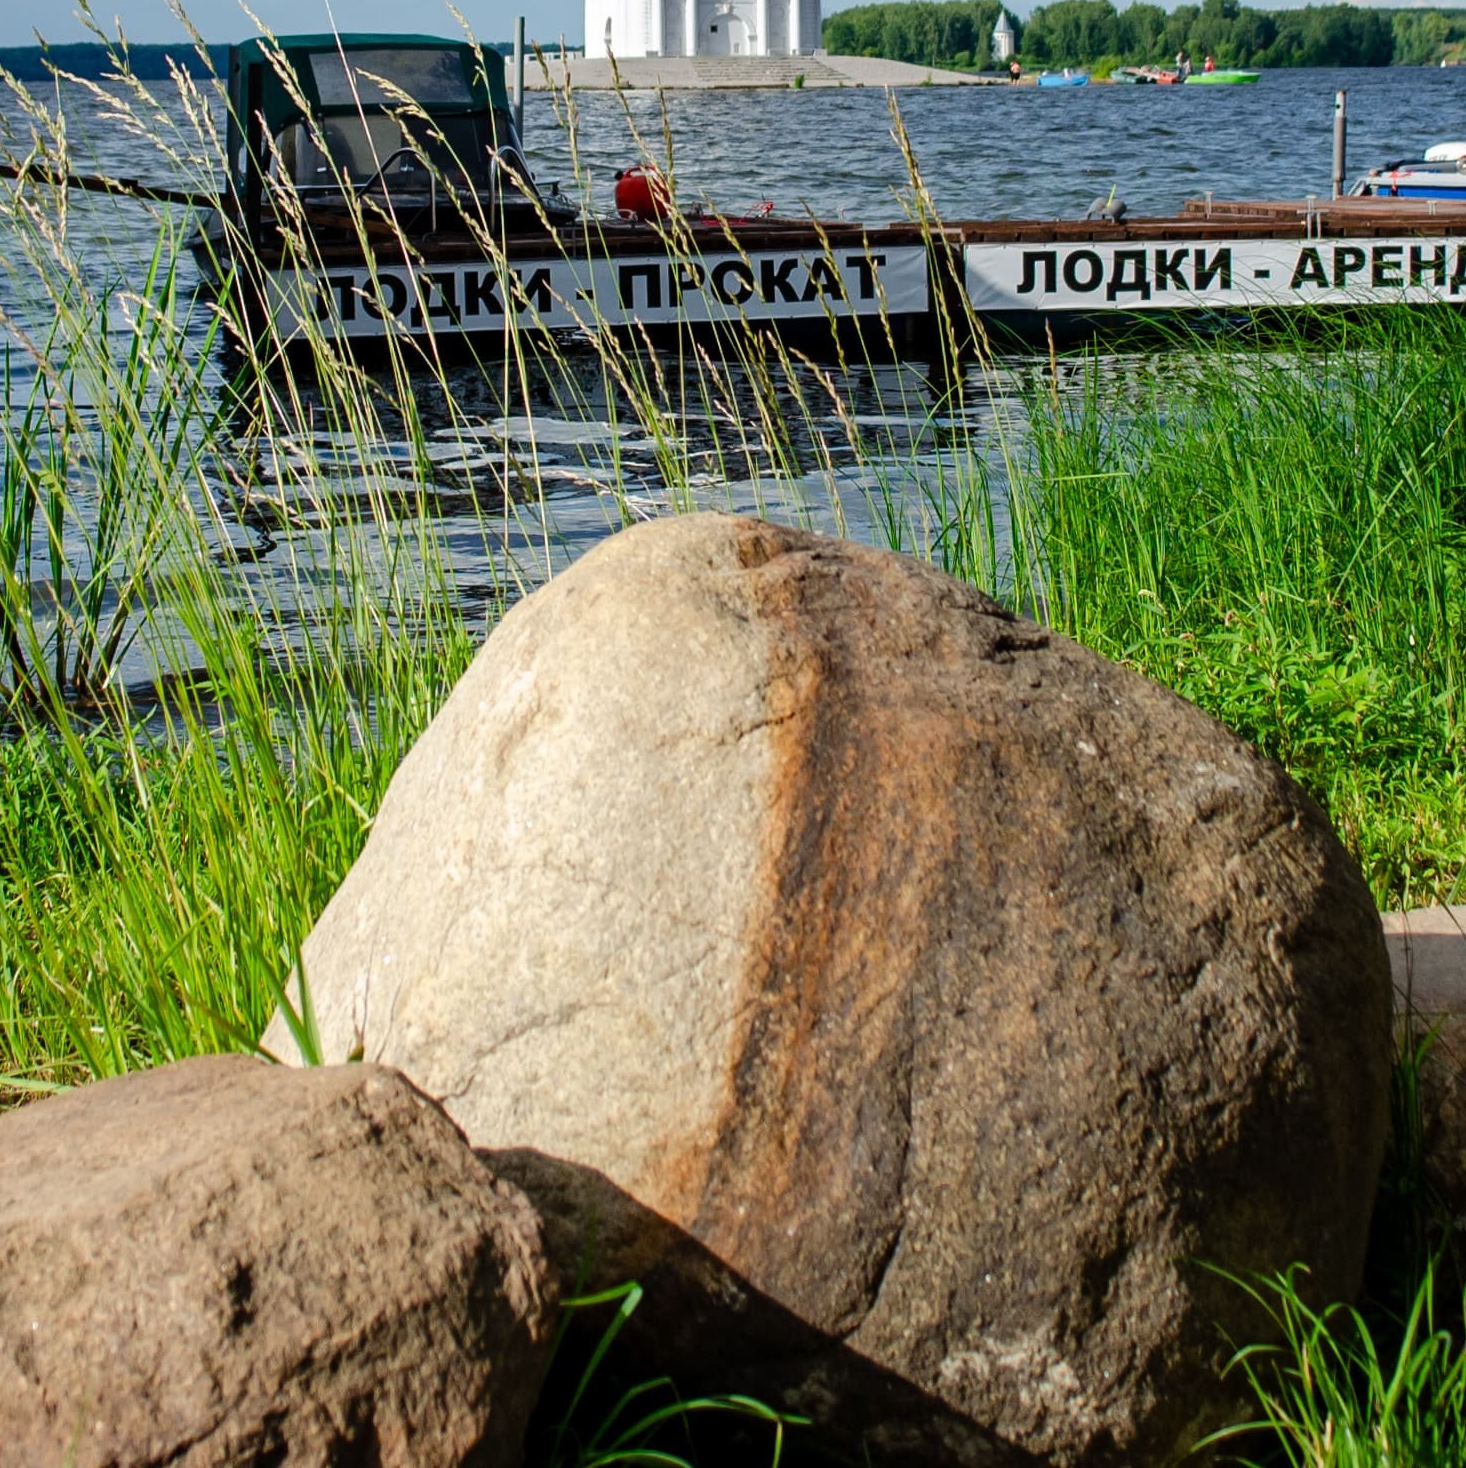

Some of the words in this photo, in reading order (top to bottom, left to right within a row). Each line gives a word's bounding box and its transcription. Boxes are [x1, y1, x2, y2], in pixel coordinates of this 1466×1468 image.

[310, 268, 552, 328] ЛОДКИ
[618, 254, 886, 310] ПРОКАТ
[1016, 248, 1232, 301] ЛОДКИ
